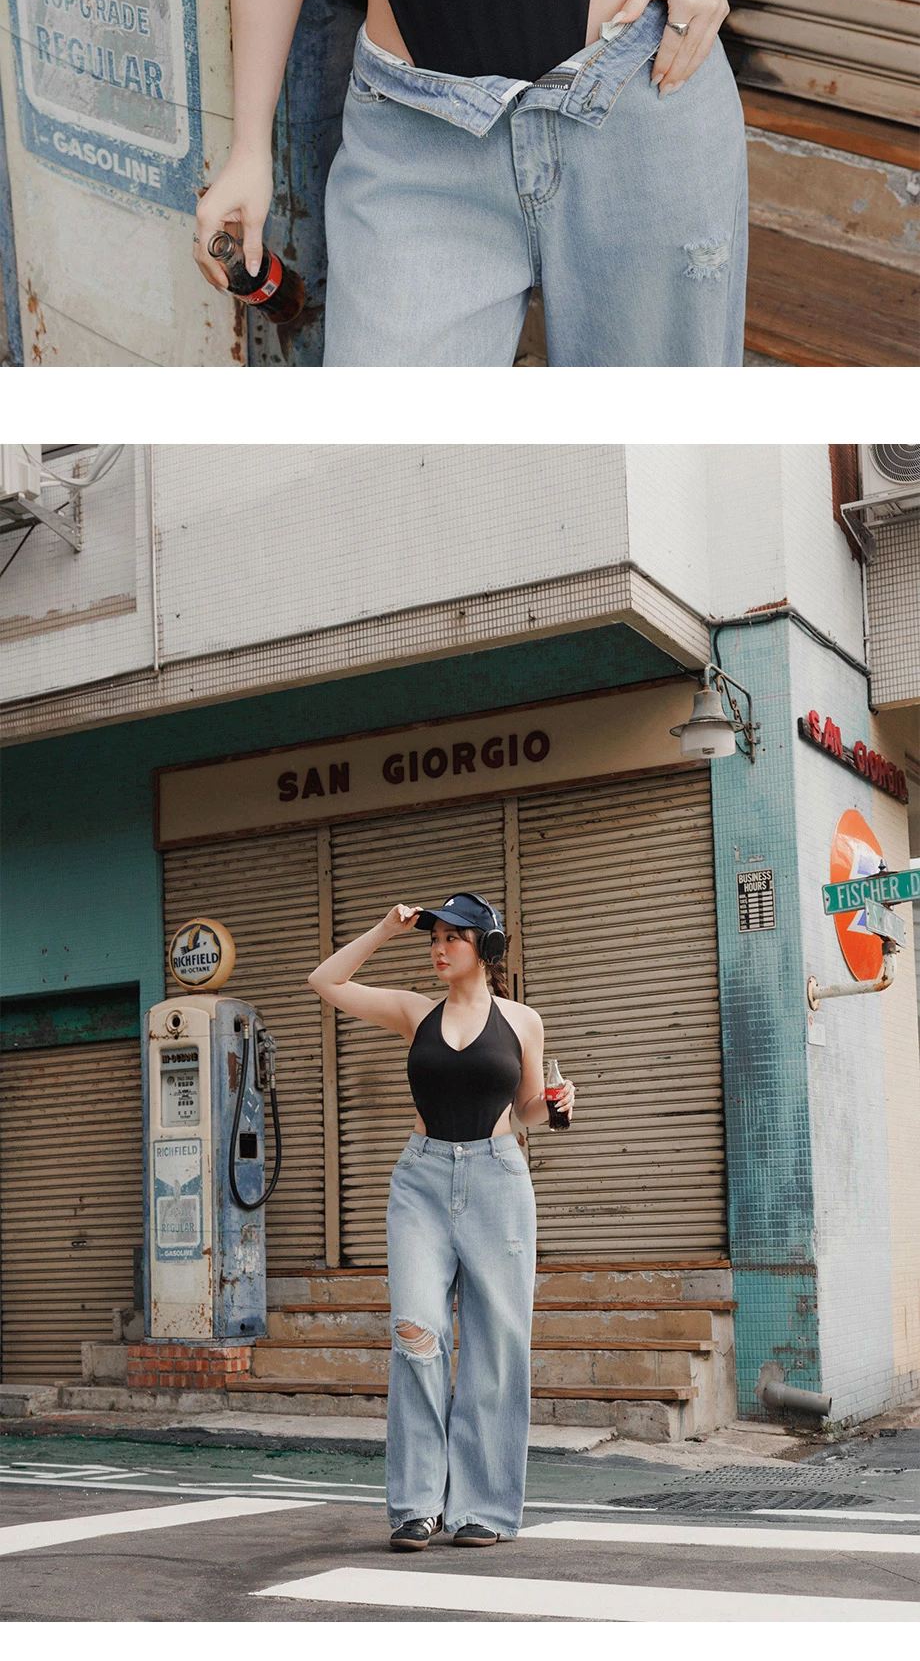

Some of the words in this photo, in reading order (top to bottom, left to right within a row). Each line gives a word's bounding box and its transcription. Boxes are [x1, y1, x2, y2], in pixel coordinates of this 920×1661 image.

[36, 25, 164, 100] REGULAR
[53, 131, 162, 189] GASOLINE
[808, 710, 844, 758] SAN
[277, 761, 351, 802] SAN
[382, 730, 551, 785] GIORGIO
[739, 871, 772, 884] BUSINESS
[743, 881, 768, 893] HOURS
[837, 876, 900, 909] FISCHER
[173, 952, 219, 969] RICHFIELD
[156, 1144, 198, 1158] RICHFIELD
